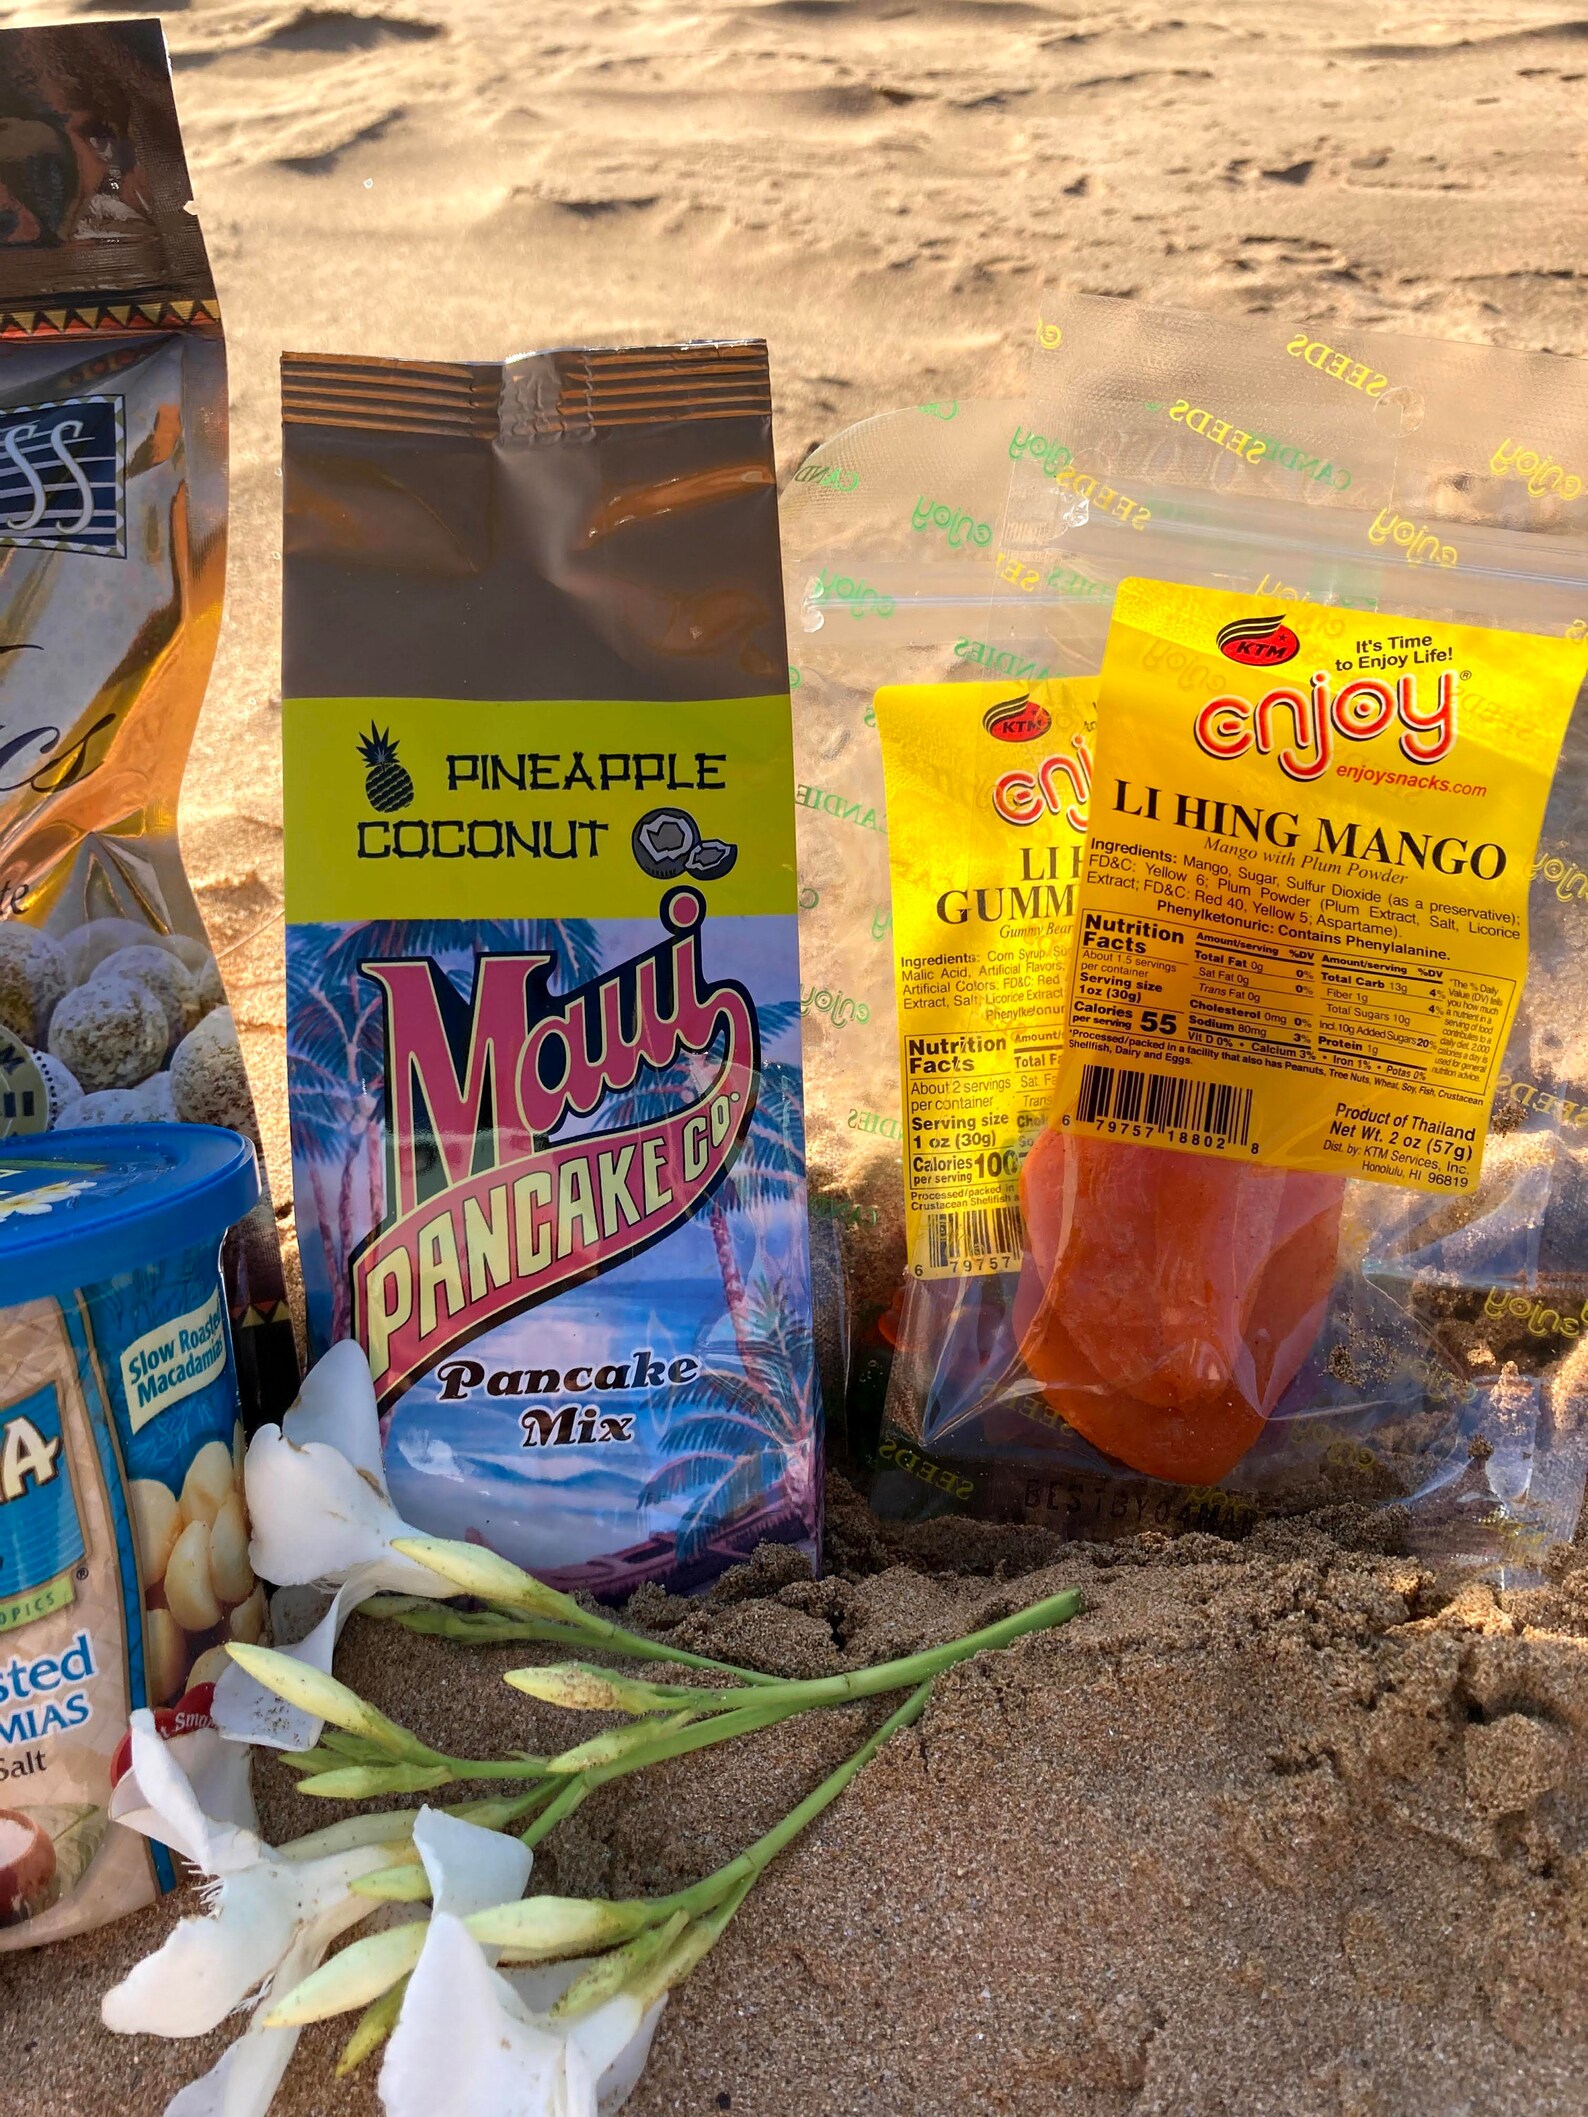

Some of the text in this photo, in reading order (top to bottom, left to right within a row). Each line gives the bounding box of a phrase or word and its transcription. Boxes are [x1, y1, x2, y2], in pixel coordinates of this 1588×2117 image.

[1235, 640, 1289, 660] KTM
[1355, 633, 1434, 655] It's Time
[1334, 646, 1454, 672] to Enjoy Life!
[1194, 669, 1460, 782] enjoy
[445, 750, 728, 792] PINEAPPLE
[1335, 762, 1488, 798] enjoysnacks.com
[357, 819, 610, 860] COCONUT
[1112, 778, 1162, 821] LI
[1173, 793, 1301, 848] HING
[1312, 817, 1507, 881] MANGO
[1019, 846, 1060, 882] LI
[1203, 836, 1409, 885] Mango with Plum Powder
[1090, 837, 1177, 864] Ingredients:
[1182, 853, 1232, 878] Mango,
[1237, 866, 1280, 888] Sugar,
[1285, 875, 1326, 894] Sulfur
[1331, 883, 1382, 903] Dioxide
[1387, 892, 1409, 908] (as
[1414, 899, 1424, 910] a
[1429, 901, 1521, 927] preservative);
[1086, 870, 1402, 940] Extract; FD&C: Red 40, Yellow 5; Aspartame).
[1088, 853, 1137, 873] FD&C:
[1144, 861, 1188, 882] Yellow
[1195, 873, 1209, 889] 6;
[1217, 877, 1251, 896] Plum
[1260, 886, 1311, 908] Powder
[1319, 898, 1360, 916] (Plum
[1368, 905, 1420, 927] Extract,
[1429, 914, 1459, 933] Salt,
[1468, 920, 1521, 940] Licorice
[999, 923, 1045, 941] Gummy
[1082, 930, 1147, 954] Facts
[1084, 913, 1184, 945] Nutrition
[1156, 899, 1451, 961] Phenylketonuric: Contains Phenylalanine.
[1194, 931, 1281, 957] Amount/serving
[1080, 961, 1150, 978] per container
[1081, 946, 1114, 962] About
[1117, 953, 1133, 965] 1.5
[1134, 957, 1177, 974] servings
[1193, 949, 1247, 969] Total Fat
[1321, 954, 1408, 978] Amount/serving
[1078, 983, 1142, 1004] 1oz (30g)
[1079, 971, 1163, 993] Serving size
[1198, 981, 1245, 1000] Trans Fat
[1320, 971, 1408, 996] Total Carb 13g
[1326, 987, 1353, 1000] Fiber
[1071, 1014, 1132, 1031] per serving
[1073, 1000, 1177, 1035] Calories 55
[1189, 998, 1287, 1026] Cholesterol 0mg
[1325, 1002, 1411, 1027] Total Sugars 10g
[1188, 1014, 1267, 1039] Sodium 80mg
[1337, 1022, 1417, 1046] 10g Added Sugars
[360, 885, 758, 1223] Maui
[908, 1035, 1007, 1057] Nutrition
[1068, 1038, 1193, 1066] Shellfish, Dairy and Eggs.
[1317, 1035, 1363, 1052] Protein
[909, 1055, 975, 1074] Facts
[1186, 1044, 1484, 1106] facility that also has Peanuts, Tree Nuts, Soy, Crustacean
[910, 1077, 1012, 1096] About servings
[910, 1094, 994, 1115] per container
[911, 1114, 976, 1132] Serving
[980, 1111, 1009, 1127] size
[1094, 1117, 1227, 1151] 79757 18802
[1334, 1101, 1476, 1142] Product of Thailand
[928, 1129, 996, 1151] oz (30g)
[1329, 1119, 1473, 1162] Net Wt. 2 oz (57g)
[912, 1150, 974, 1173] Calories
[1322, 1138, 1470, 1175] Dist. by: KTM Services, Inc.
[913, 1170, 972, 1187] per serving
[1361, 1159, 1469, 1188] Honolulu, HI 96819
[366, 1089, 742, 1386] PANCAKE CO.
[949, 1256, 1011, 1275] 79757
[128, 1310, 222, 1385] Slow Roaste
[435, 1351, 701, 1404] Pancake
[519, 1405, 635, 1450] Mix
